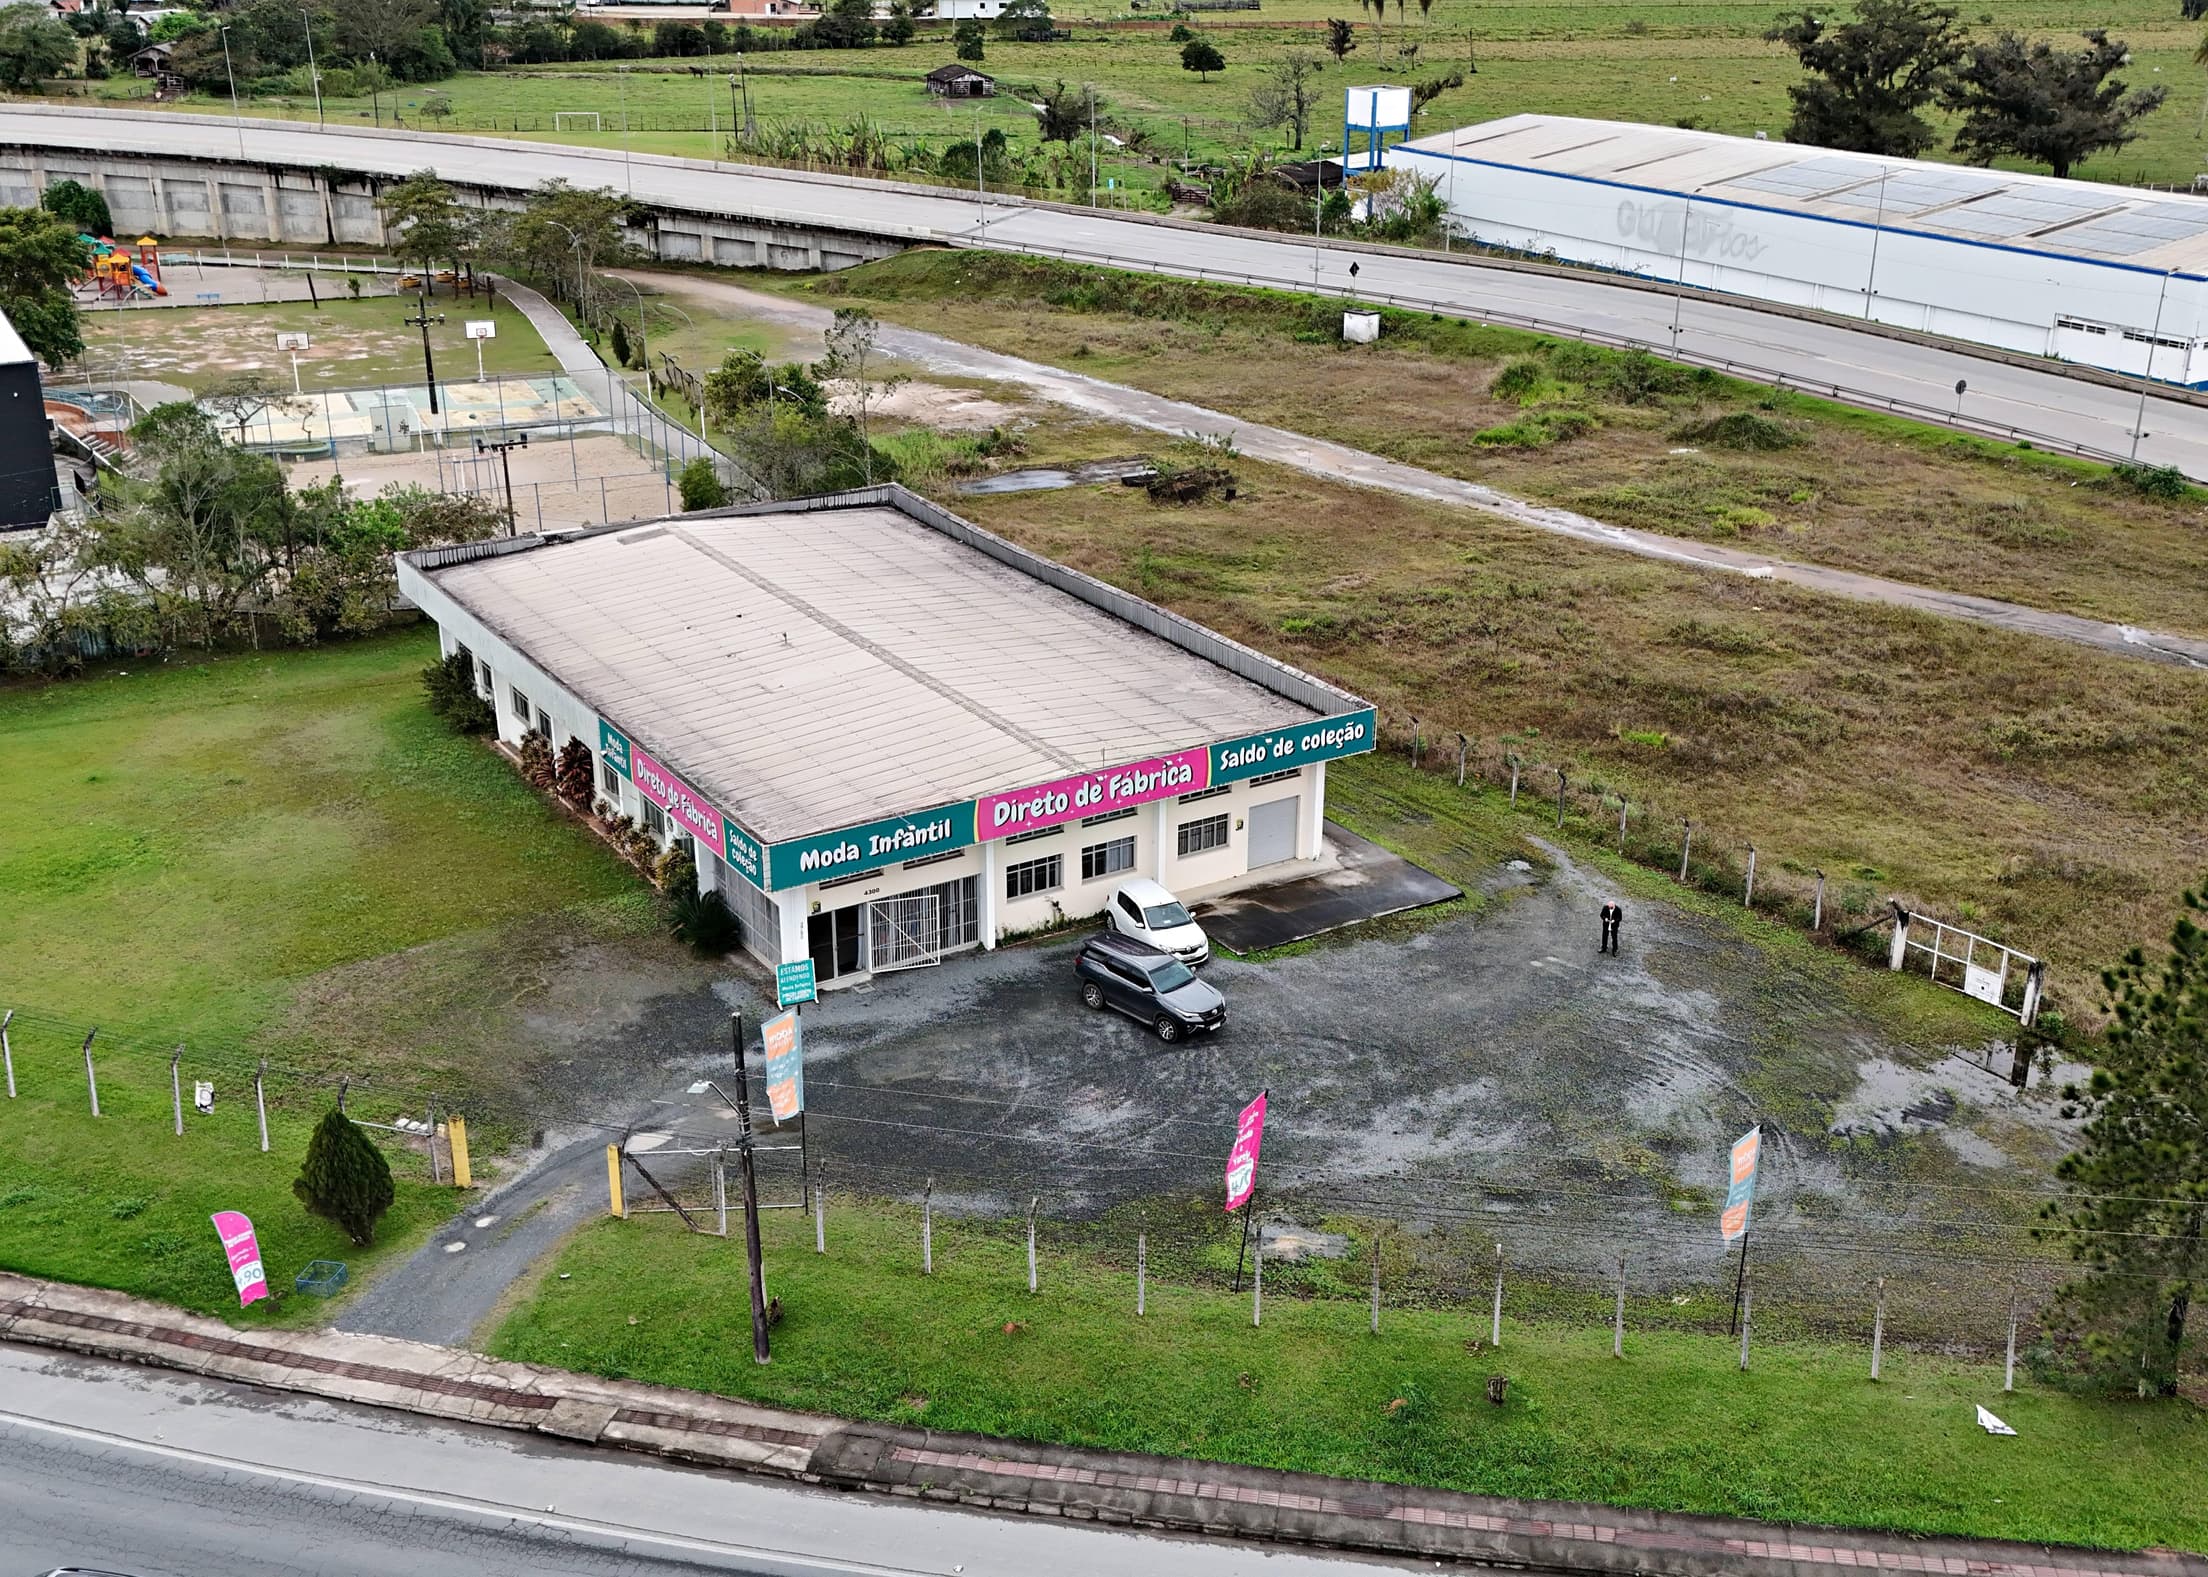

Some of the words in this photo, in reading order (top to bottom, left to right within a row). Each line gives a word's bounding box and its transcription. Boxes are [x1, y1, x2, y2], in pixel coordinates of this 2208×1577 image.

[607, 732, 623, 754] Moda
[1220, 743, 1267, 771] Saldo
[1273, 737, 1295, 758] de
[1301, 721, 1365, 749] coleção
[637, 758, 666, 799] Direto
[667, 783, 680, 809] de
[681, 793, 718, 841] Fábrica
[993, 790, 1068, 828] Direto
[1075, 780, 1104, 808] de
[1109, 763, 1193, 800] Fábrica
[729, 829, 747, 852] Saldo
[748, 844, 757, 860] de
[732, 848, 757, 876] coleção
[800, 841, 860, 872] Moda
[868, 818, 952, 857] Infantil
[863, 887, 880, 896] 4300
